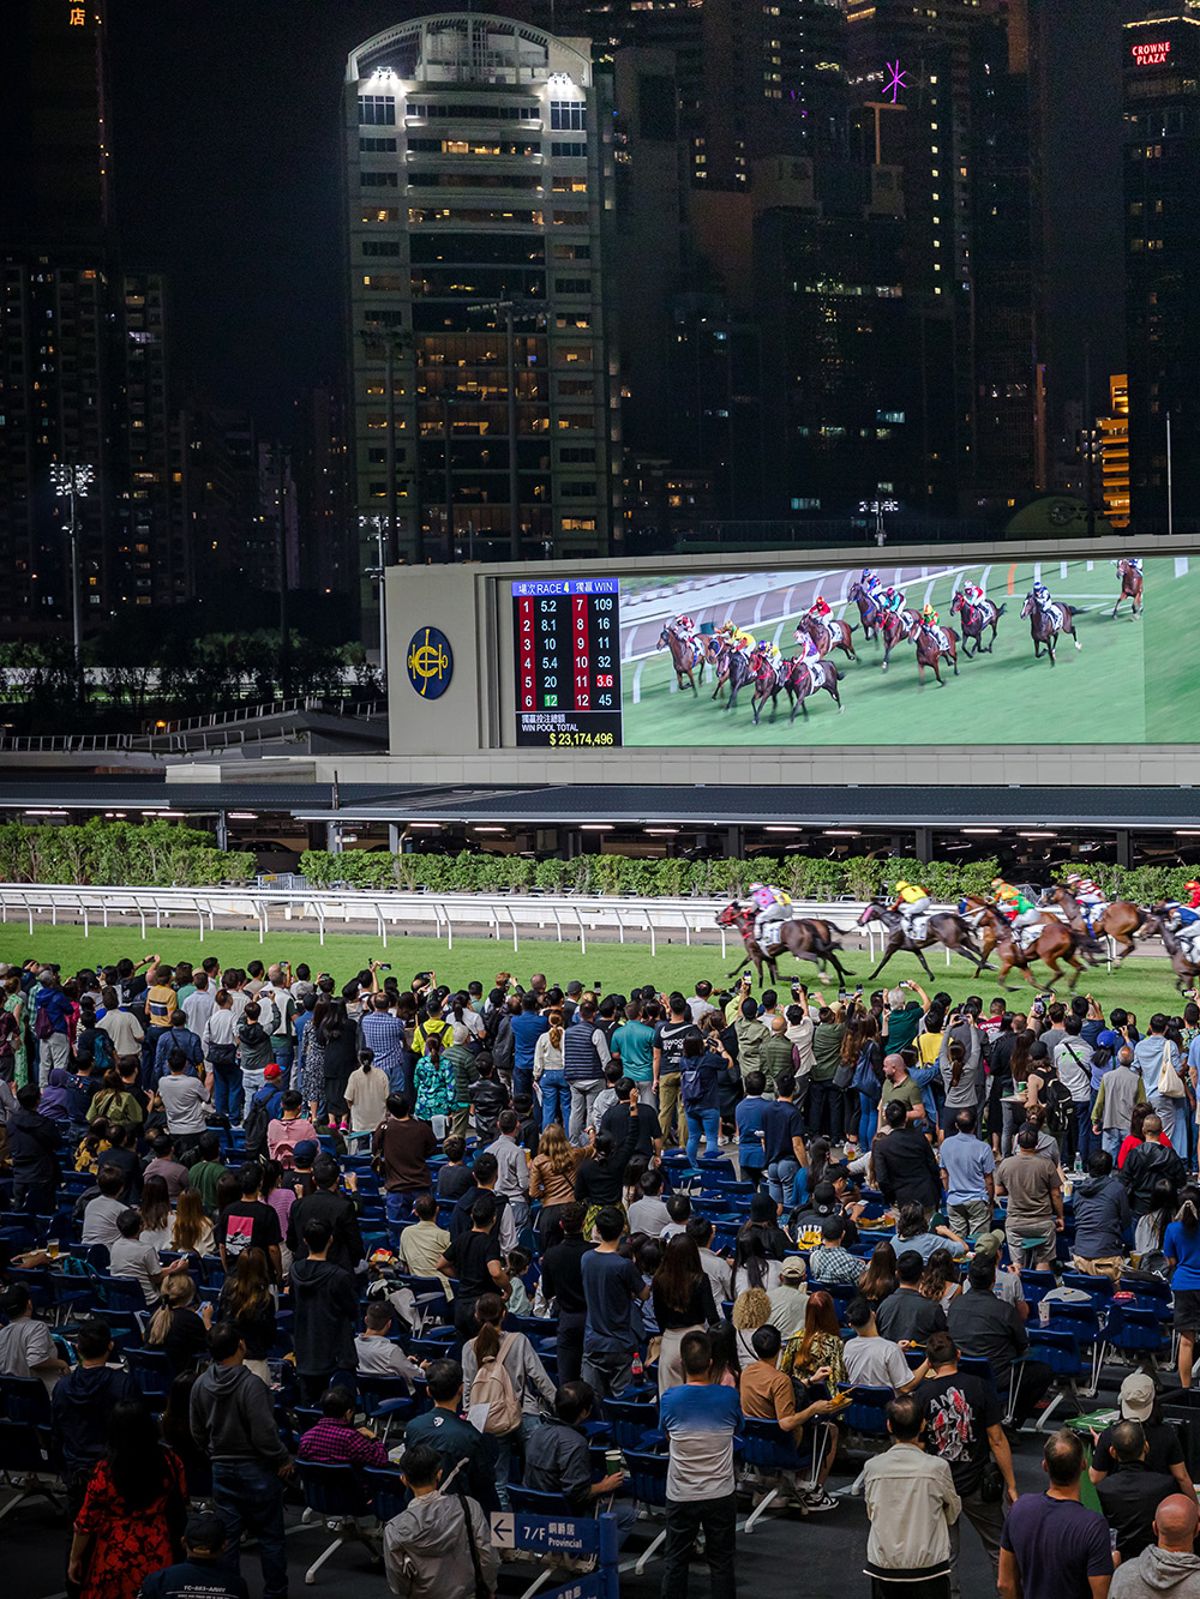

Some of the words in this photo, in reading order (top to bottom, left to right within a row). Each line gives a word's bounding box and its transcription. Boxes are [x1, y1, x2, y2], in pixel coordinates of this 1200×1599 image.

[1132, 41, 1170, 56] CROWNE
[1136, 53, 1166, 66] PLAZA
[518, 584, 536, 594] 場次
[538, 584, 561, 593] RACE
[563, 582, 569, 593] 4
[595, 582, 612, 592] WIN
[523, 601, 529, 612] 1
[541, 601, 556, 612] 5.2
[577, 600, 583, 611] 7
[594, 599, 612, 610] 109
[523, 620, 530, 631] 2
[541, 620, 556, 631] 8.1
[577, 618, 584, 630] 8
[598, 618, 610, 630] 16
[524, 639, 531, 650] 3
[544, 638, 556, 650] 10
[578, 638, 584, 649] 9
[598, 637, 609, 648] 11
[524, 658, 531, 668] 4
[542, 657, 558, 668] 5.4
[576, 657, 588, 668] 10
[598, 656, 611, 667] 32
[525, 677, 532, 688] 5
[544, 676, 557, 688] 20
[576, 676, 587, 687] 11
[597, 675, 612, 687] 3.6
[525, 696, 532, 707] 6
[545, 695, 558, 706] 12
[577, 695, 589, 706] 12
[599, 694, 612, 706] 45
[559, 733, 613, 746] 23,174,496
[523, 1526, 546, 1541] 7/F
[548, 1537, 582, 1549] Provincial
